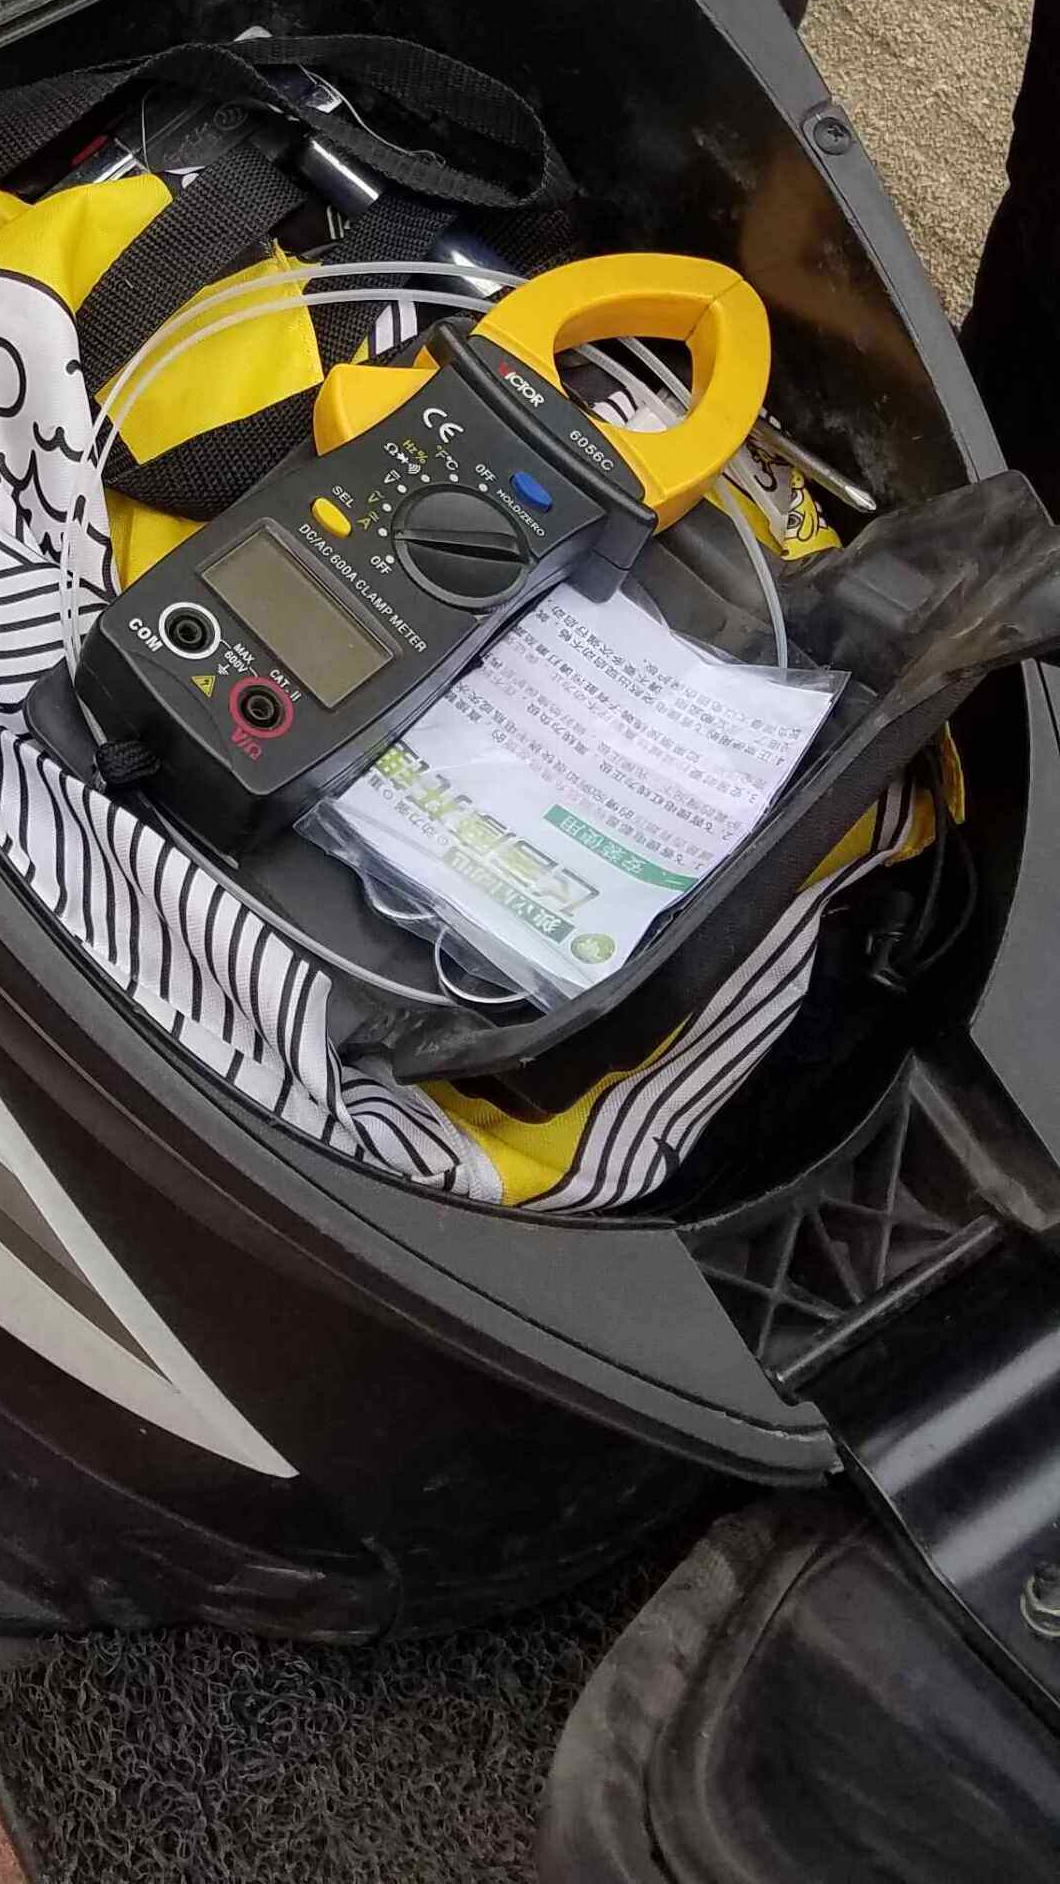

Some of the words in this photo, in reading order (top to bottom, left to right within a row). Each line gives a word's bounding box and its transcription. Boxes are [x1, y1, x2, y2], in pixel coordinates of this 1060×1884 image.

[498, 359, 545, 407] VICTOR
[422, 407, 464, 443] CE
[570, 430, 614, 471] 6056C
[474, 463, 496, 481] OFF
[331, 485, 354, 509] SEL
[496, 488, 545, 537] HOLD/ZERO
[370, 555, 392, 574] OFF
[298, 523, 333, 556] DC/AC
[329, 553, 358, 582] 600A
[355, 579, 393, 615] CLAMP
[389, 614, 427, 653] METER
[128, 617, 163, 652] COM
[223, 650, 248, 673] 600V
[232, 642, 255, 665] MAX
